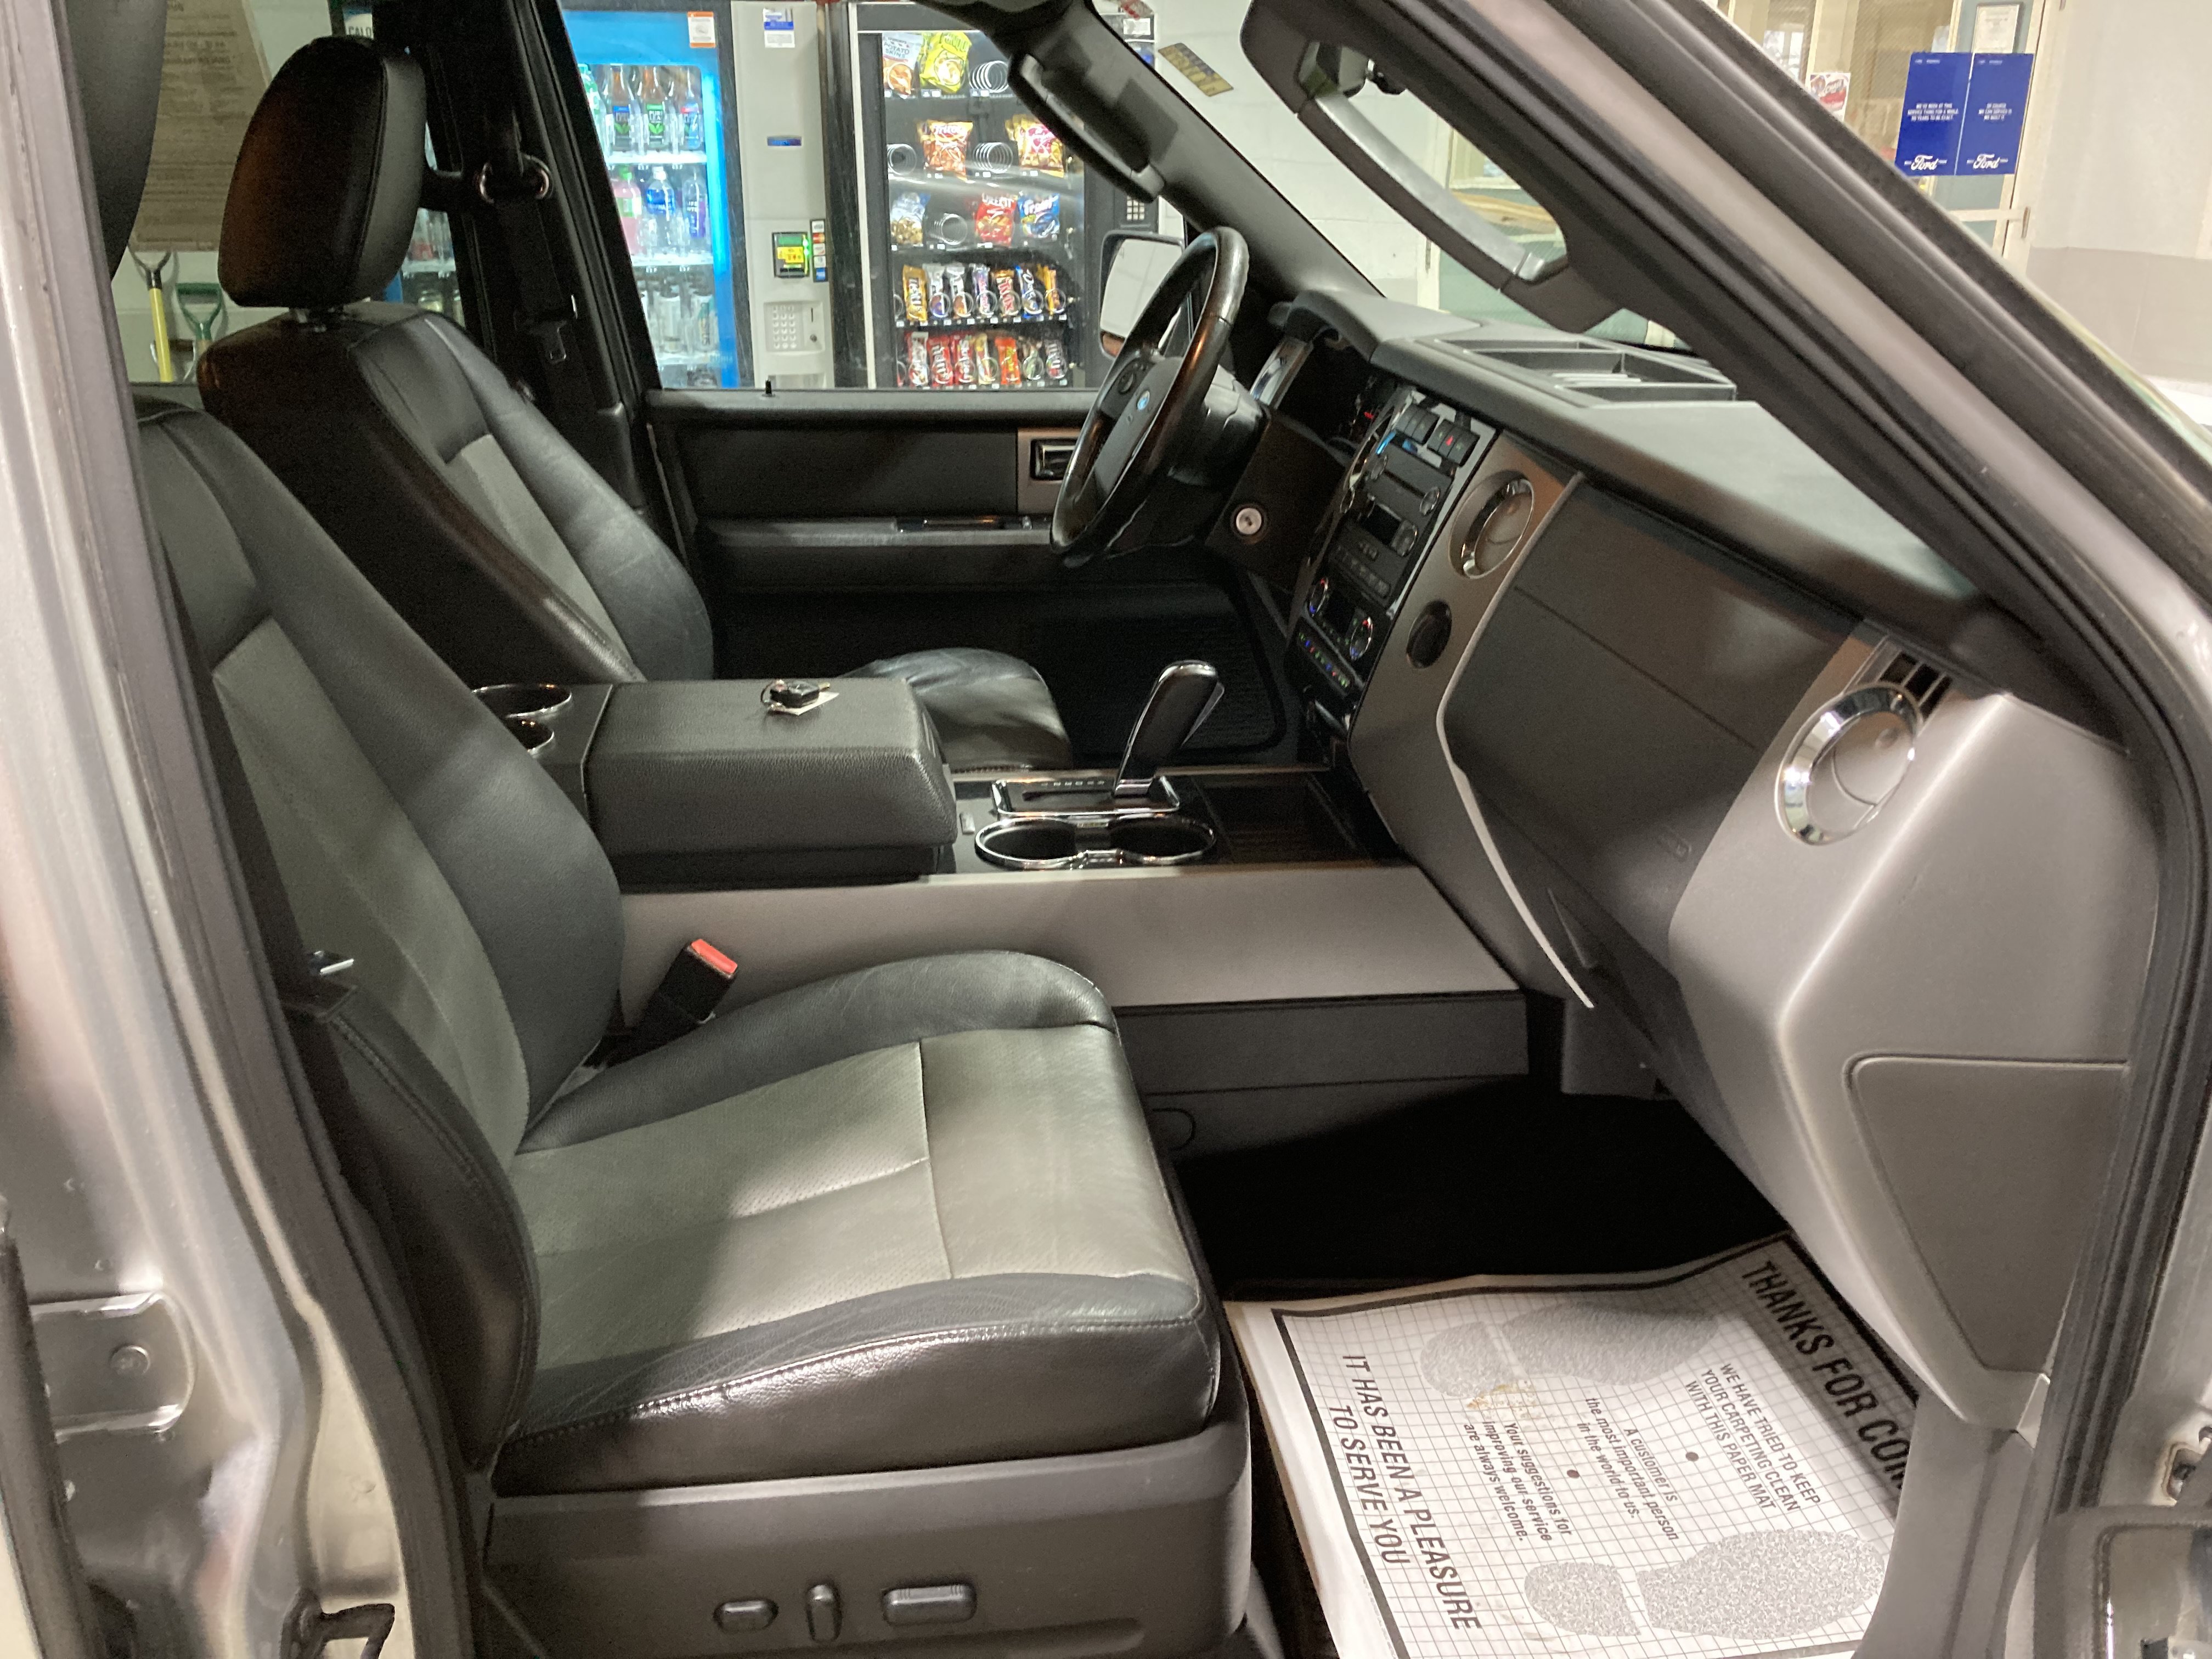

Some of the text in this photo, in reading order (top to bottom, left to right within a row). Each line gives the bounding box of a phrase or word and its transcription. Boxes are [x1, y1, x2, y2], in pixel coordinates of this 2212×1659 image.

[1911, 154, 1939, 170] Ford
[1973, 154, 2000, 169] Ford
[1742, 1261, 1835, 1355] THANKS
[1812, 1358, 1879, 1418] FOR
[1329, 1405, 1410, 1564] TO SERVE YOU
[1342, 1355, 1482, 1630] IT HAS BEEN A PLEASURE
[1464, 1424, 1527, 1542] are always welcome.
[1482, 1421, 1553, 1541] improving our service
[1504, 1423, 1572, 1535] Your suggestions for
[1577, 1423, 1640, 1519] in the world to us.
[1585, 1398, 1679, 1540] the most important person
[1631, 1438, 1671, 1488] customer
[1663, 1491, 1678, 1502] is
[1685, 1380, 1776, 1509] WITH THIS PAPER MAT
[1701, 1369, 1801, 1511] YOUR CARPETING CLEAN
[1720, 1363, 1821, 1504] WE HAVE TRIED TO KEEP
